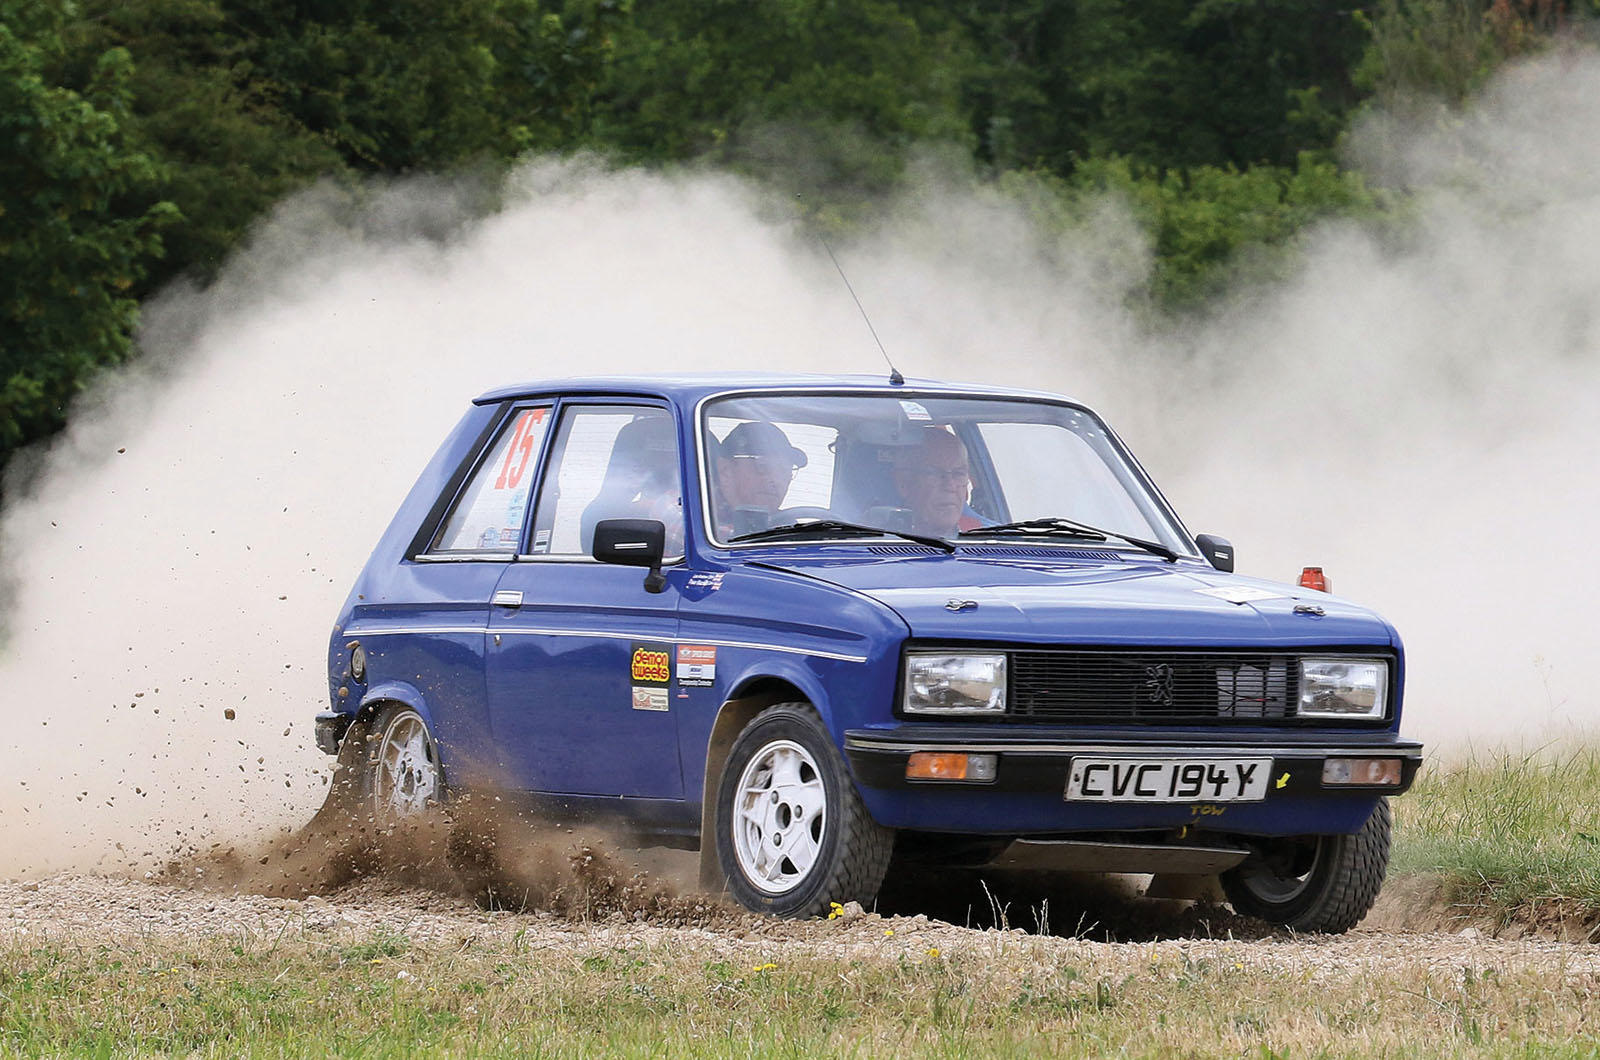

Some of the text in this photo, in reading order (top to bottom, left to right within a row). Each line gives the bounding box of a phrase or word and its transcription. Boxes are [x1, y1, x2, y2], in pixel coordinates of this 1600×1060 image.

[494, 408, 546, 490] 15
[634, 651, 668, 666] demon
[632, 664, 669, 680] tweeks
[1190, 804, 1226, 816] TOW
